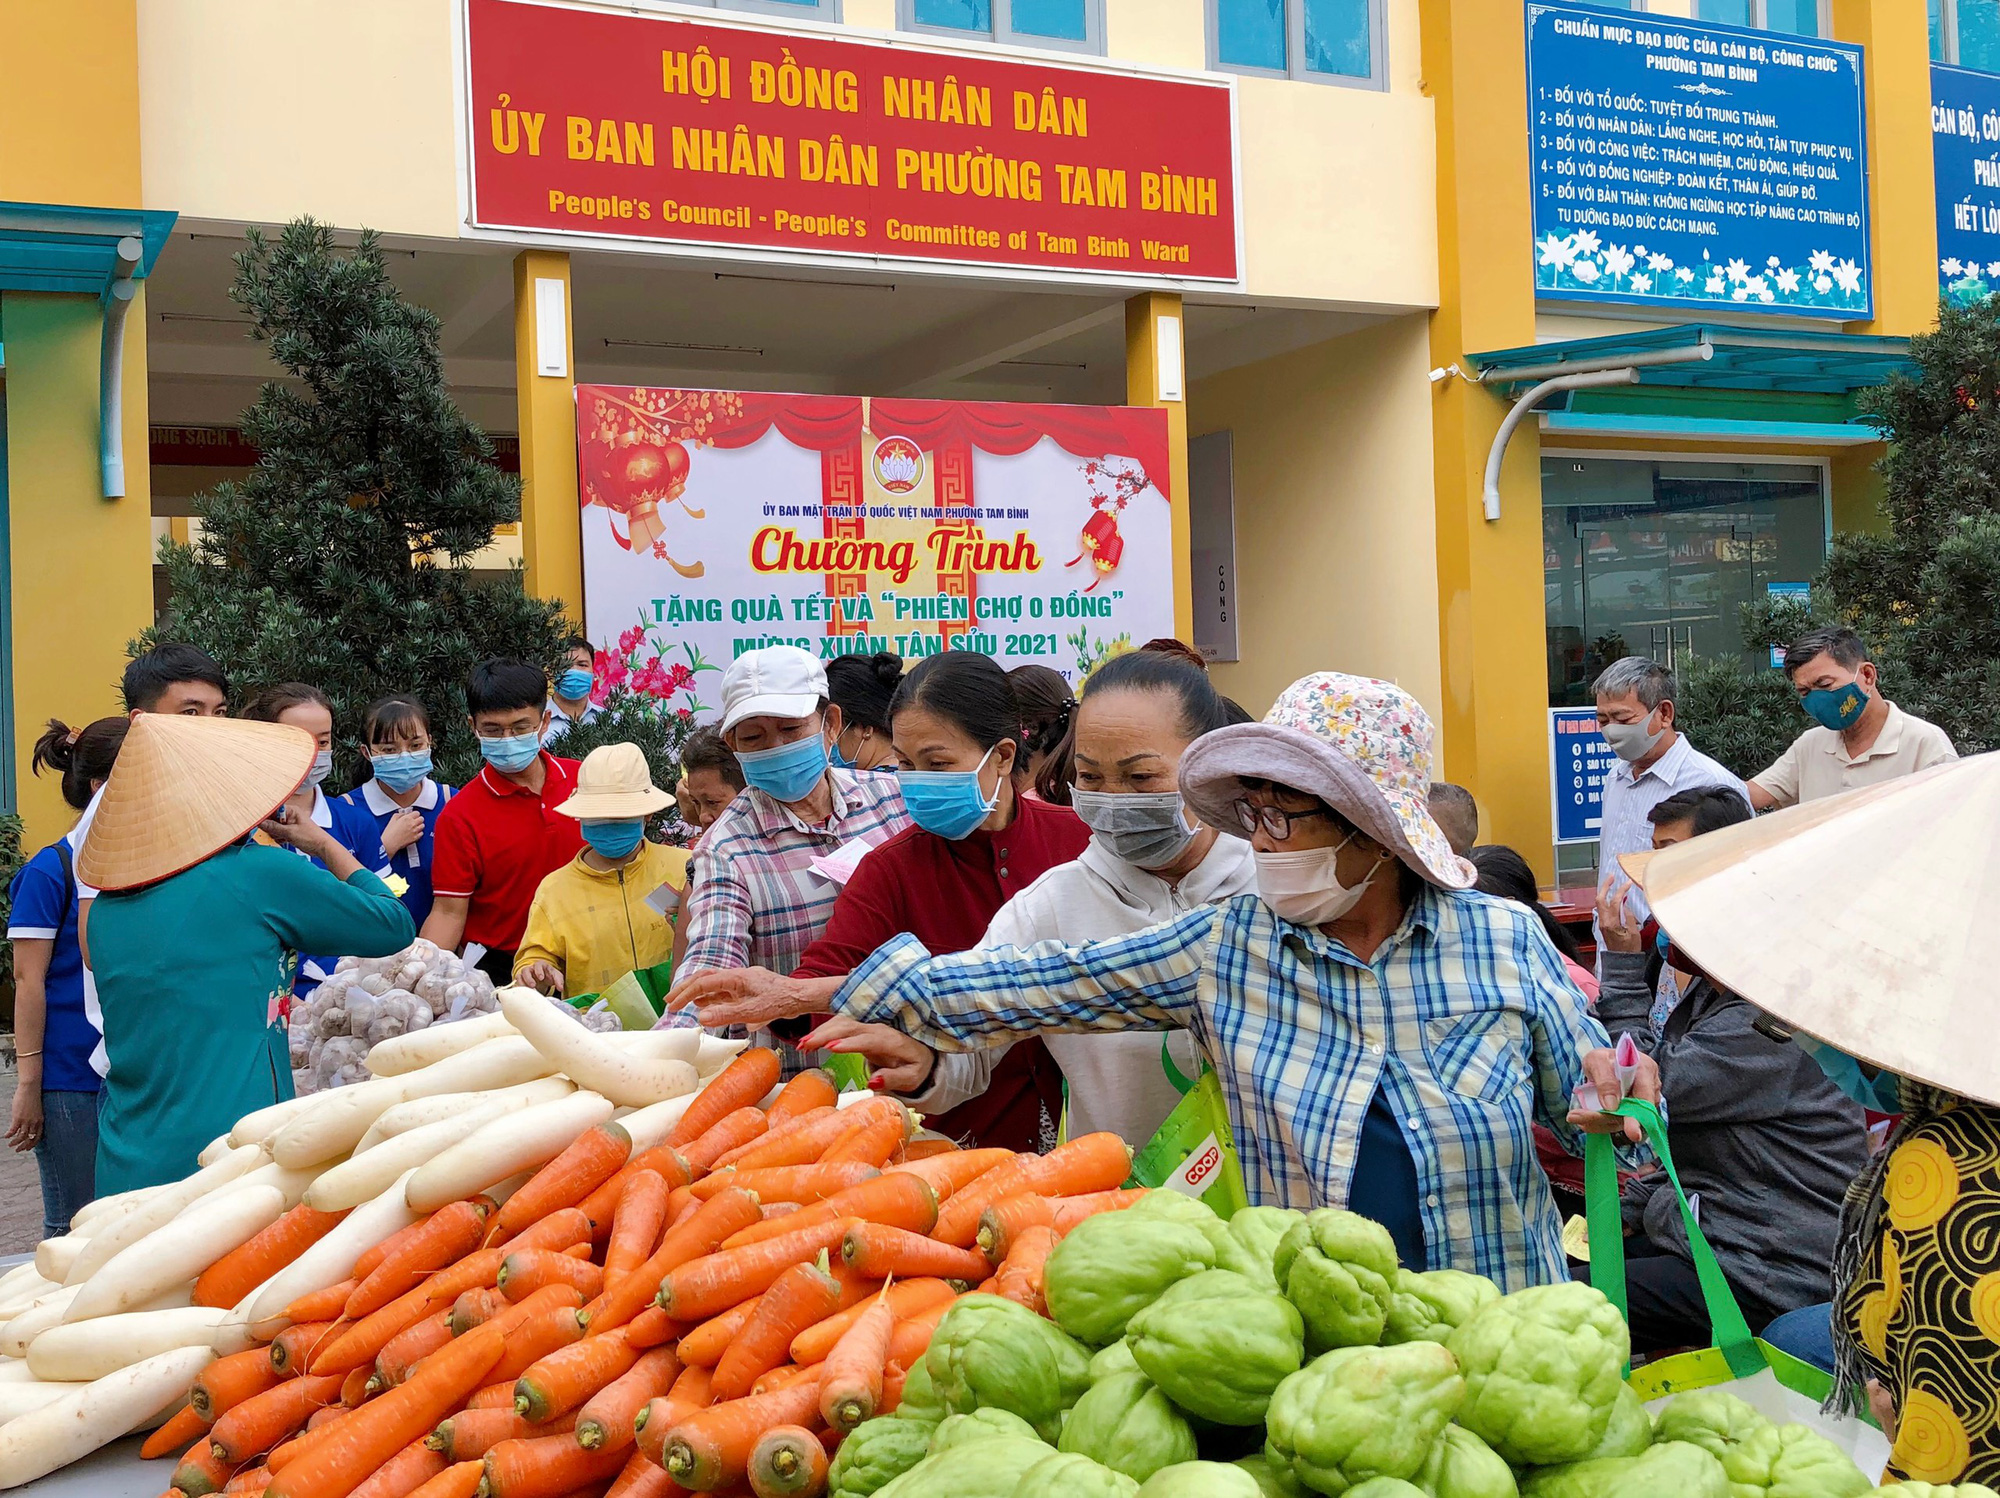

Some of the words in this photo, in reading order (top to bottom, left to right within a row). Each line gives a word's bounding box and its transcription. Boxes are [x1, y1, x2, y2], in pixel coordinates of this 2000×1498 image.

[1554, 18, 1600, 39] CHUẨN
[1603, 26, 1632, 45] MỰC
[1636, 30, 1661, 49] ĐẠO
[1665, 33, 1690, 51] ĐỨC
[1693, 36, 1718, 55] CỦA
[1721, 42, 1746, 59] CÁN
[1749, 45, 1769, 65] BỘ,
[1772, 49, 1804, 68] CÔNG
[1807, 55, 1837, 73] CHỨC
[1646, 54, 1697, 75] PHƯỜNG
[1700, 62, 1725, 78] TAM
[1728, 63, 1758, 83] BÌNH
[662, 45, 731, 104] HỘI
[750, 47, 858, 113] ĐỒNG
[883, 75, 992, 127] NHÂN
[1013, 86, 1088, 137] DÂN
[1539, 87, 1544, 100] 1
[1555, 84, 1573, 104] ĐỐI
[1576, 89, 1594, 106] VỚI
[1597, 87, 1612, 108] TỔ
[1614, 92, 1647, 113] QUỐC:
[1650, 99, 1683, 119] TUYỆT
[1686, 100, 1703, 119] ĐỐI
[1705, 107, 1740, 124] TRUNG
[1742, 110, 1778, 129] THÀNH.
[1540, 111, 1546, 124] 2
[1555, 108, 1574, 128] ĐỐI
[1577, 113, 1595, 130] VỚI
[1598, 115, 1627, 134] NHÂN
[1631, 119, 1655, 137] DÂN:
[1658, 119, 1686, 140] LẮNG
[1689, 128, 1720, 147] NGHE,
[1723, 132, 1744, 149] HỌC
[1746, 130, 1766, 152] HỎI,
[1768, 135, 1787, 154] TẬN
[1790, 140, 1808, 156] TỤY
[1811, 143, 1836, 159] PHỤC
[1839, 146, 1854, 162] VỤ.
[1931, 100, 1956, 135] CÁN
[1958, 104, 1980, 143] BỘ,
[1983, 108, 2000, 142] CÔ
[490, 93, 546, 156] ỦY
[566, 116, 654, 166] BAN
[672, 124, 785, 178] NHÂN
[799, 134, 879, 187] DÂN
[896, 145, 1042, 202] PHƯỜNG
[1055, 164, 1127, 209] TAM
[1140, 165, 1217, 216] BÌNH
[1541, 135, 1546, 149] 3
[1556, 132, 1574, 152] ĐỐI
[1578, 136, 1595, 154] VỚI
[1598, 139, 1629, 158] CÔNG
[1632, 143, 1659, 162] VIỆC:
[1662, 146, 1696, 165] TRÁCH
[1699, 151, 1734, 171] NHIỆM,
[1736, 153, 1757, 171] CHỦ
[1759, 157, 1790, 177] ĐỘNG,
[1792, 161, 1815, 179] HIỆU
[1817, 163, 1839, 180] QUẢ.
[1974, 152, 2000, 187] PHẤ
[1541, 159, 1547, 173] 4
[1557, 156, 1575, 176] ĐỐI
[1578, 160, 1596, 178] VỚI
[1599, 160, 1630, 181] ĐỒNG
[1633, 168, 1675, 187] NGHIỆP:
[1678, 171, 1706, 189] ĐOÀN
[1708, 172, 1730, 193] KẾT,
[1732, 177, 1759, 194] THÂN
[1761, 178, 1774, 198] ÁI,
[1776, 181, 1799, 198] GIÚP
[1801, 184, 1818, 200] ĐỠ.
[549, 190, 650, 220] People's
[662, 200, 750, 228] Council
[774, 209, 867, 237] People's
[886, 218, 1000, 249] Committee
[1008, 231, 1027, 251] of
[1037, 232, 1077, 254] Tam
[1087, 236, 1130, 258] Binh
[1141, 240, 1190, 263] Ward
[1543, 184, 1548, 197] 5
[1558, 180, 1575, 199] ĐỐI
[1578, 184, 1594, 201] VỚI
[1597, 184, 1618, 204] BẢN
[1620, 190, 1650, 207] THÂN:
[1653, 192, 1687, 211] KHÔNG
[1690, 195, 1724, 214] NGỪNG
[1727, 200, 1747, 219] HỌC
[1749, 201, 1767, 220] TẬP
[1769, 203, 1795, 221] NÂNG
[1797, 208, 1816, 223] CAO
[1818, 208, 1845, 226] TRÌNH
[1847, 211, 1860, 229] ĐỘ
[1557, 208, 1571, 222] TU
[1574, 207, 1610, 226] DƯỠNG
[1612, 213, 1633, 230] ĐẠO
[1636, 212, 1656, 230] ĐỨC
[1659, 213, 1685, 232] CÁCH
[1688, 219, 1719, 236] MẠNG.
[1954, 194, 1978, 232] HẾT
[1982, 201, 2000, 235] LÒ
[763, 502, 776, 516] ỦY
[779, 505, 798, 517] BAN
[802, 504, 824, 518] MẶT
[827, 504, 851, 519] TRẬN
[855, 501, 867, 518] TỔ
[870, 502, 895, 518] QUỐC
[898, 505, 918, 519] VIỆT
[920, 507, 943, 518] NAM
[945, 504, 983, 519] PHƯỜNG
[986, 508, 1004, 519] TAM
[1007, 505, 1029, 519] BÌNH
[750, 526, 919, 584] Chương
[926, 524, 1041, 572] Trình
[651, 595, 722, 627] TẶNG
[731, 594, 784, 623] QUÀ
[791, 591, 834, 621] TẾT
[841, 594, 874, 621] VÀ
[976, 595, 1022, 623] CHỢ
[819, 631, 887, 659] XUÂN
[895, 631, 942, 658] TÂN
[949, 628, 997, 656] SỬU
[1005, 634, 1057, 655] 2021
[1187, 1148, 1218, 1184] COOP
